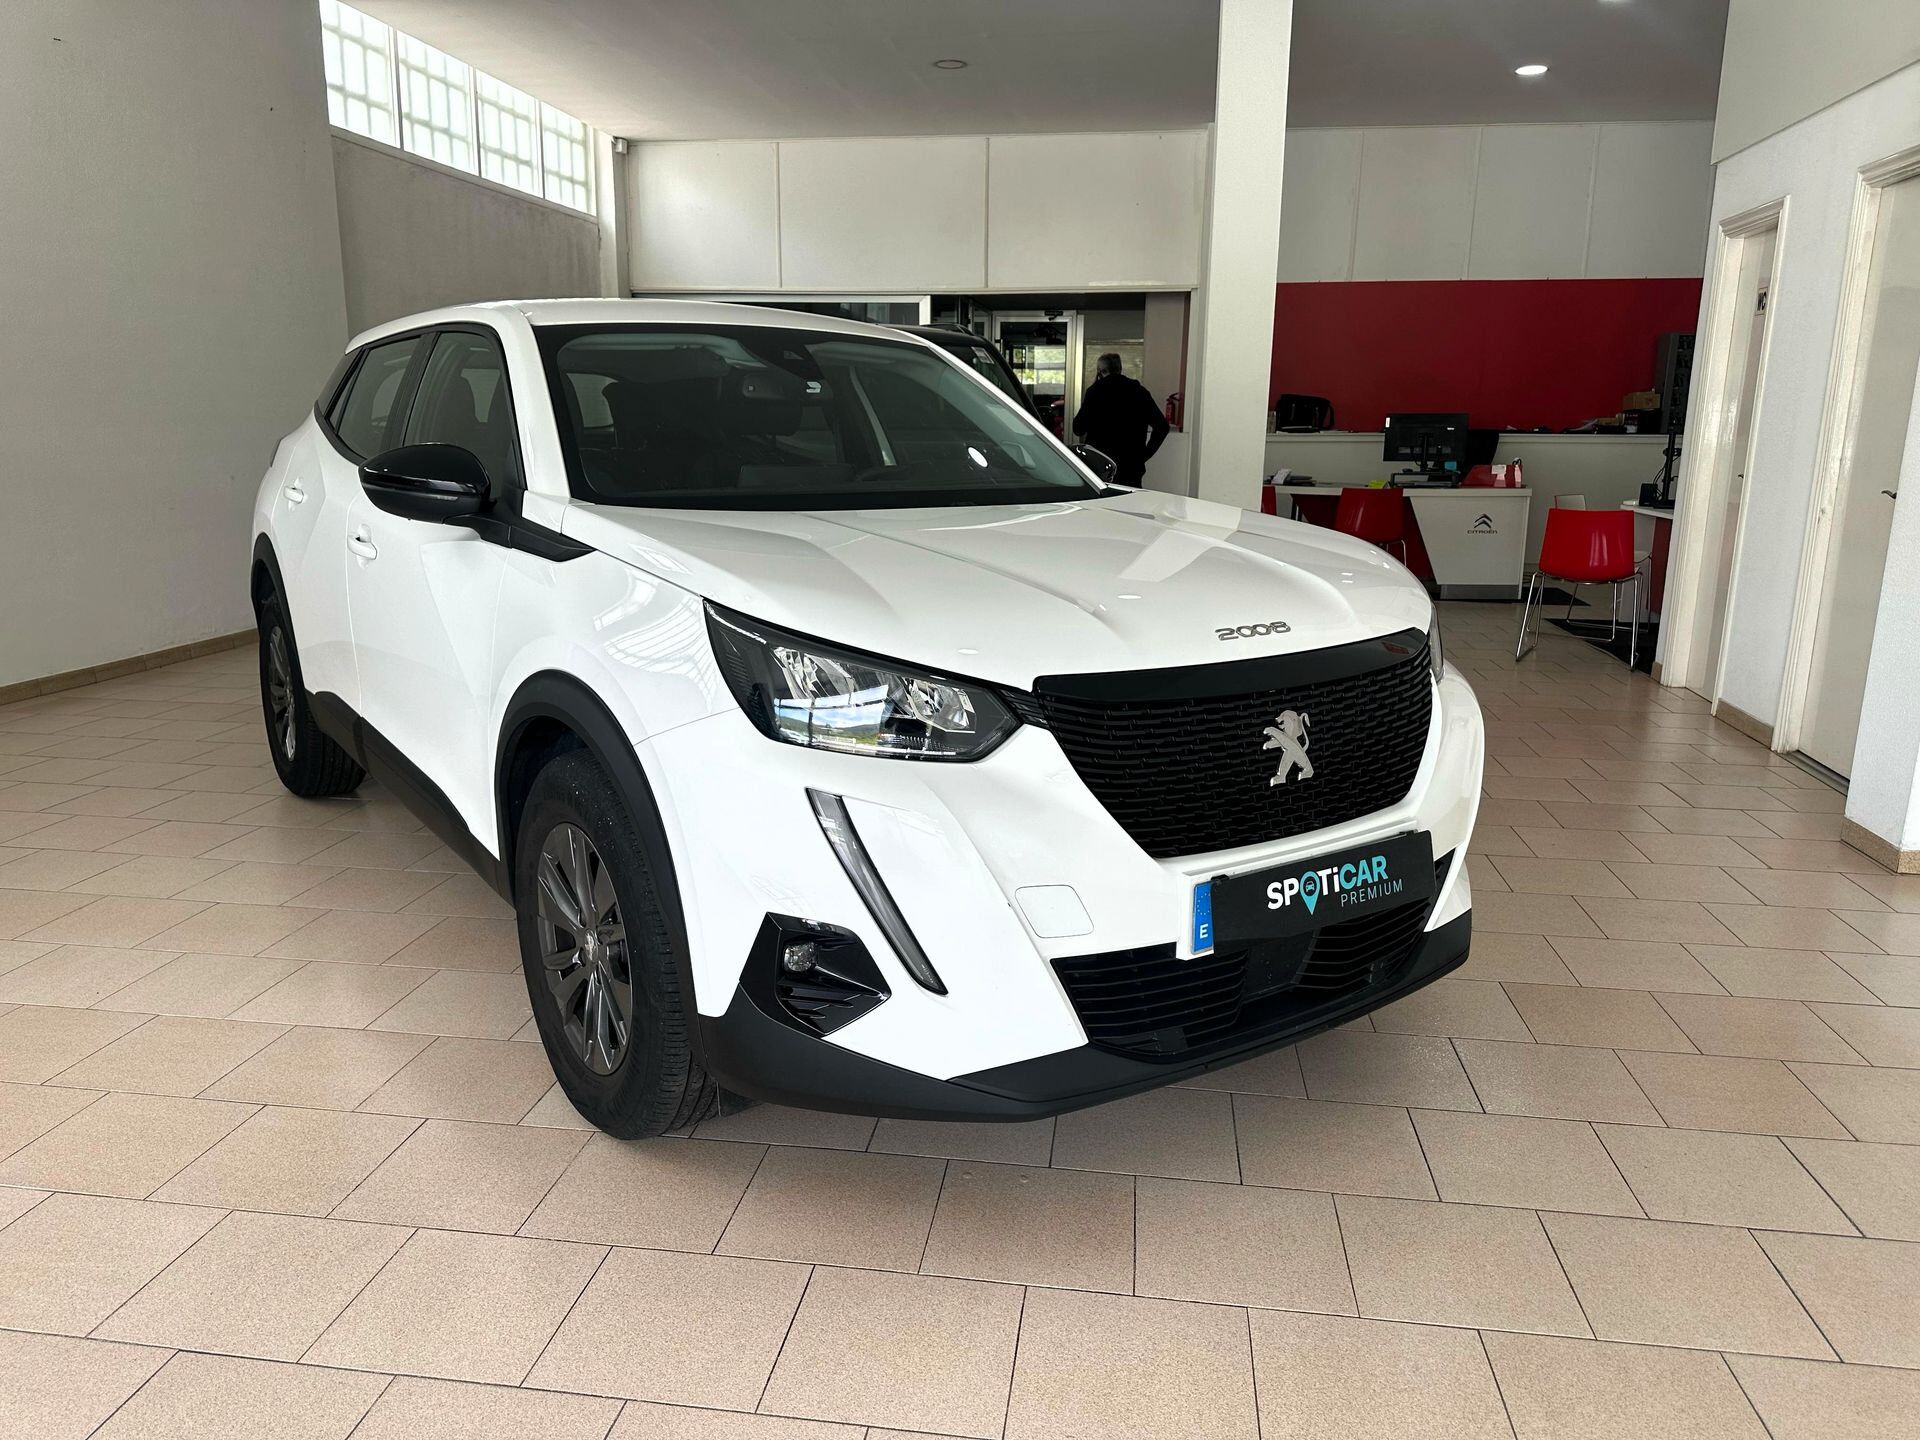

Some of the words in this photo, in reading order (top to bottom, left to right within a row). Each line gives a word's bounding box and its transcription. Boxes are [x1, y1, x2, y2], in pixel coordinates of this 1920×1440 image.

[1757, 291, 1767, 311] WC
[1215, 621, 1291, 641] 2008
[1341, 878, 1404, 908] PREMIUM
[1199, 923, 1209, 939] E
